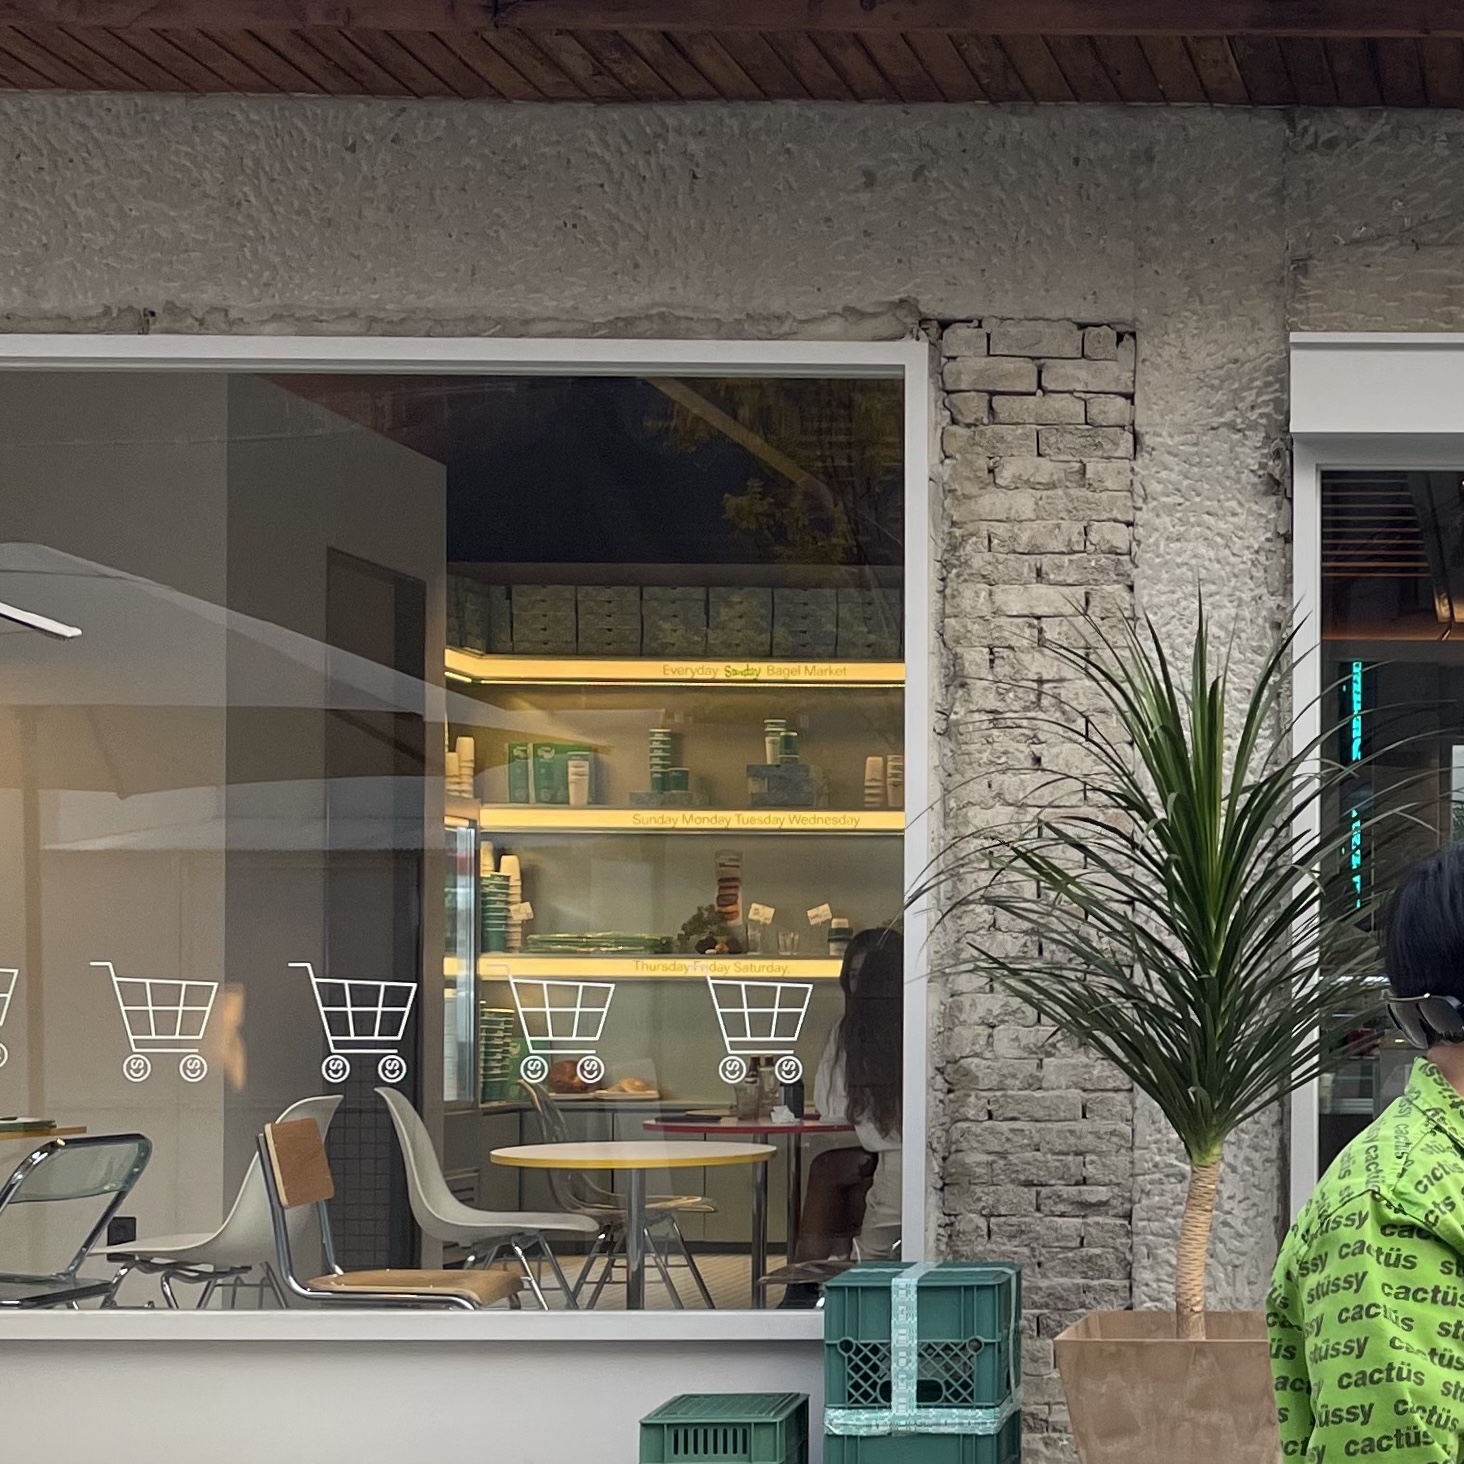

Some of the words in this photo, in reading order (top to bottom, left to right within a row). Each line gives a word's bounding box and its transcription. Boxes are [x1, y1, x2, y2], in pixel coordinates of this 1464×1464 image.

[663, 664, 718, 679] Everyday
[766, 665, 799, 680] Bagel
[804, 665, 848, 678] Market
[632, 814, 679, 829] Sunday
[682, 814, 732, 829] Monday
[735, 814, 785, 829] Tuesday
[788, 814, 861, 829] Wednesday
[634, 961, 690, 976] Thursday
[1306, 1270, 1368, 1305] stüssy
[1337, 1362, 1426, 1390] cactüs
